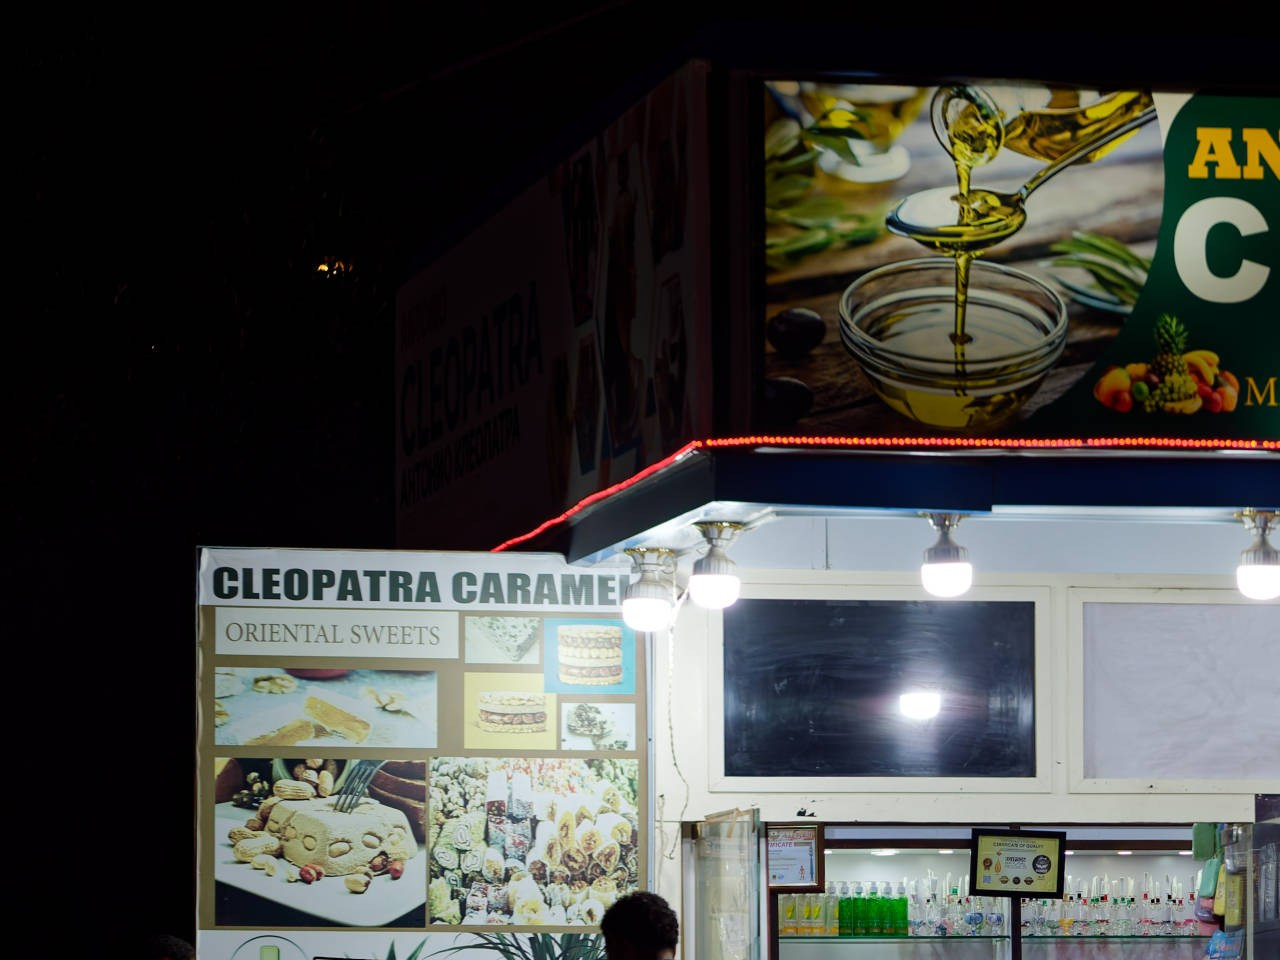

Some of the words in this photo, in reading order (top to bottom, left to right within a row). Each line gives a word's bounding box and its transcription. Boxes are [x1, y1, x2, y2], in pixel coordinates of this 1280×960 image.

[213, 565, 442, 604] CLEOPATRA
[225, 621, 345, 646] ORIENTAL
[350, 623, 441, 648] SWEETS
